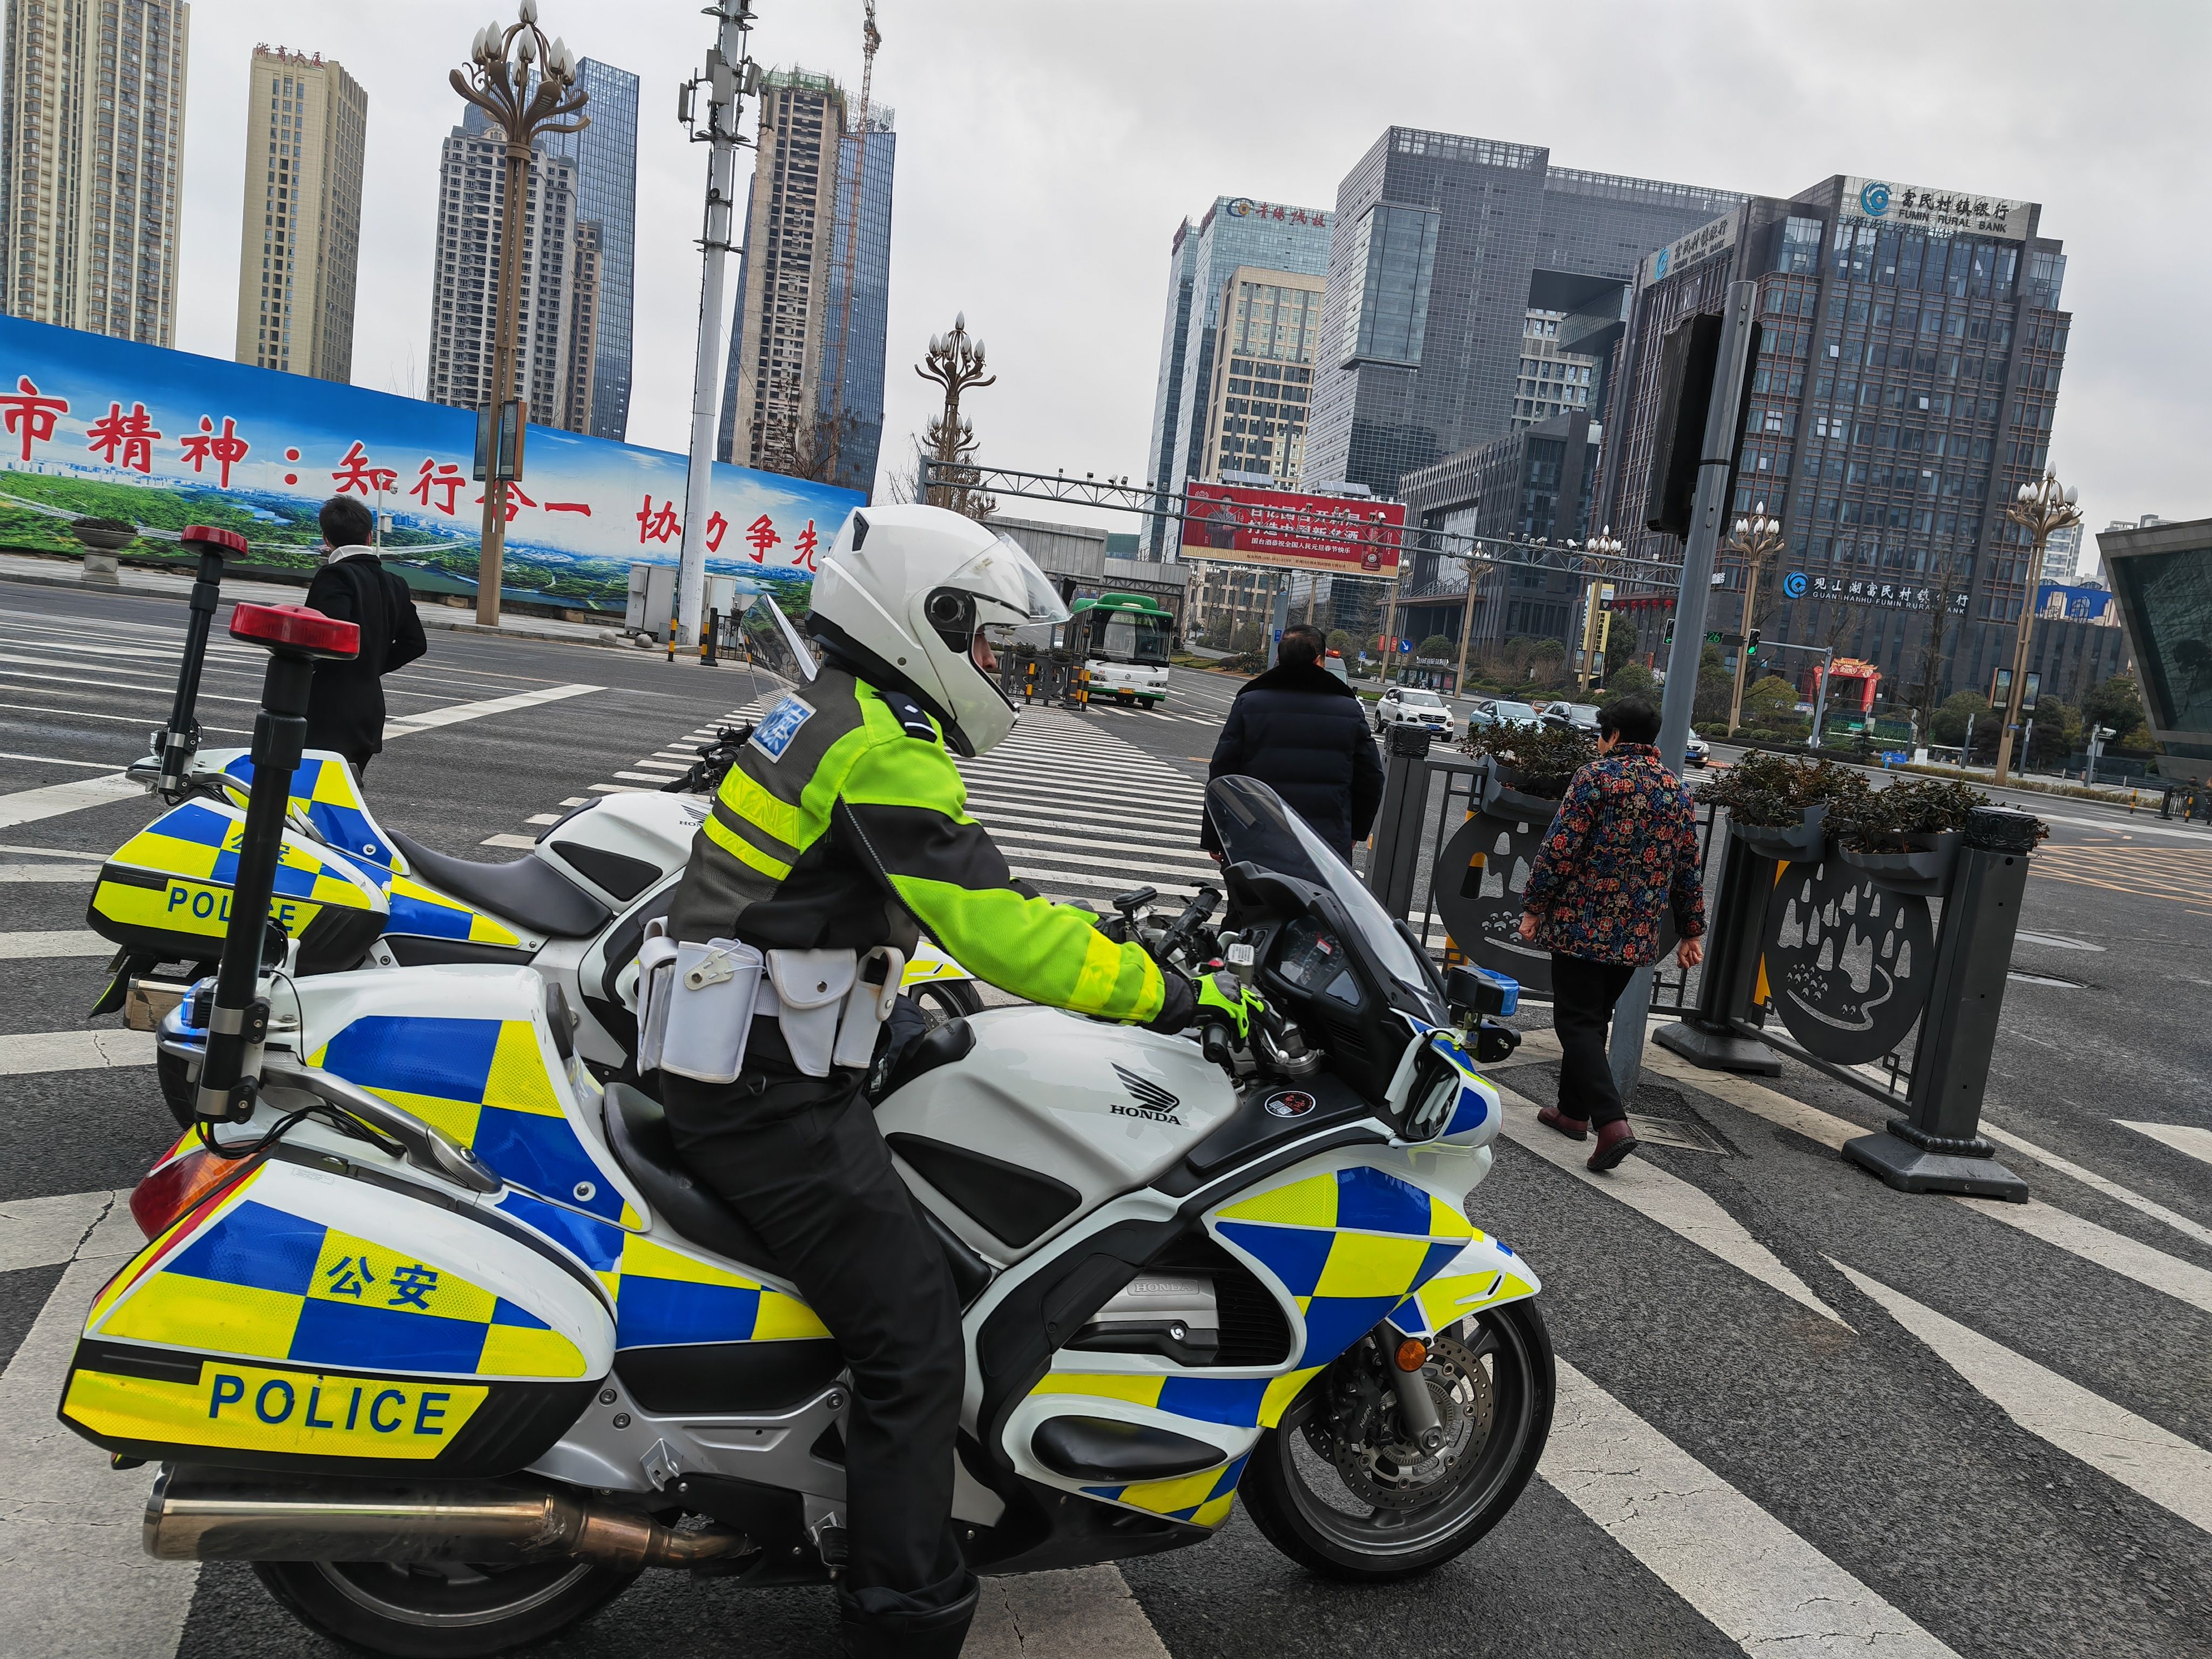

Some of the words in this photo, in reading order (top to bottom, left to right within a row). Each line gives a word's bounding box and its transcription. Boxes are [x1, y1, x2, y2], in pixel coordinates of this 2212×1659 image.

[1901, 189, 2009, 221] 富民村镇银行
[1898, 209, 1930, 222] FUMIN
[1937, 215, 1972, 227] RURAL
[1978, 220, 2007, 233] BANK
[1245, 537, 1351, 554] 国台酒恭祝全国人民元旦春节快乐
[1876, 598, 1901, 608] FUMIN
[1707, 632, 1721, 643] 26
[1109, 1104, 1182, 1126] HONDA
[326, 1255, 439, 1310] 公安
[1134, 1283, 1193, 1292] HONDA
[208, 1373, 451, 1435] POLICE
